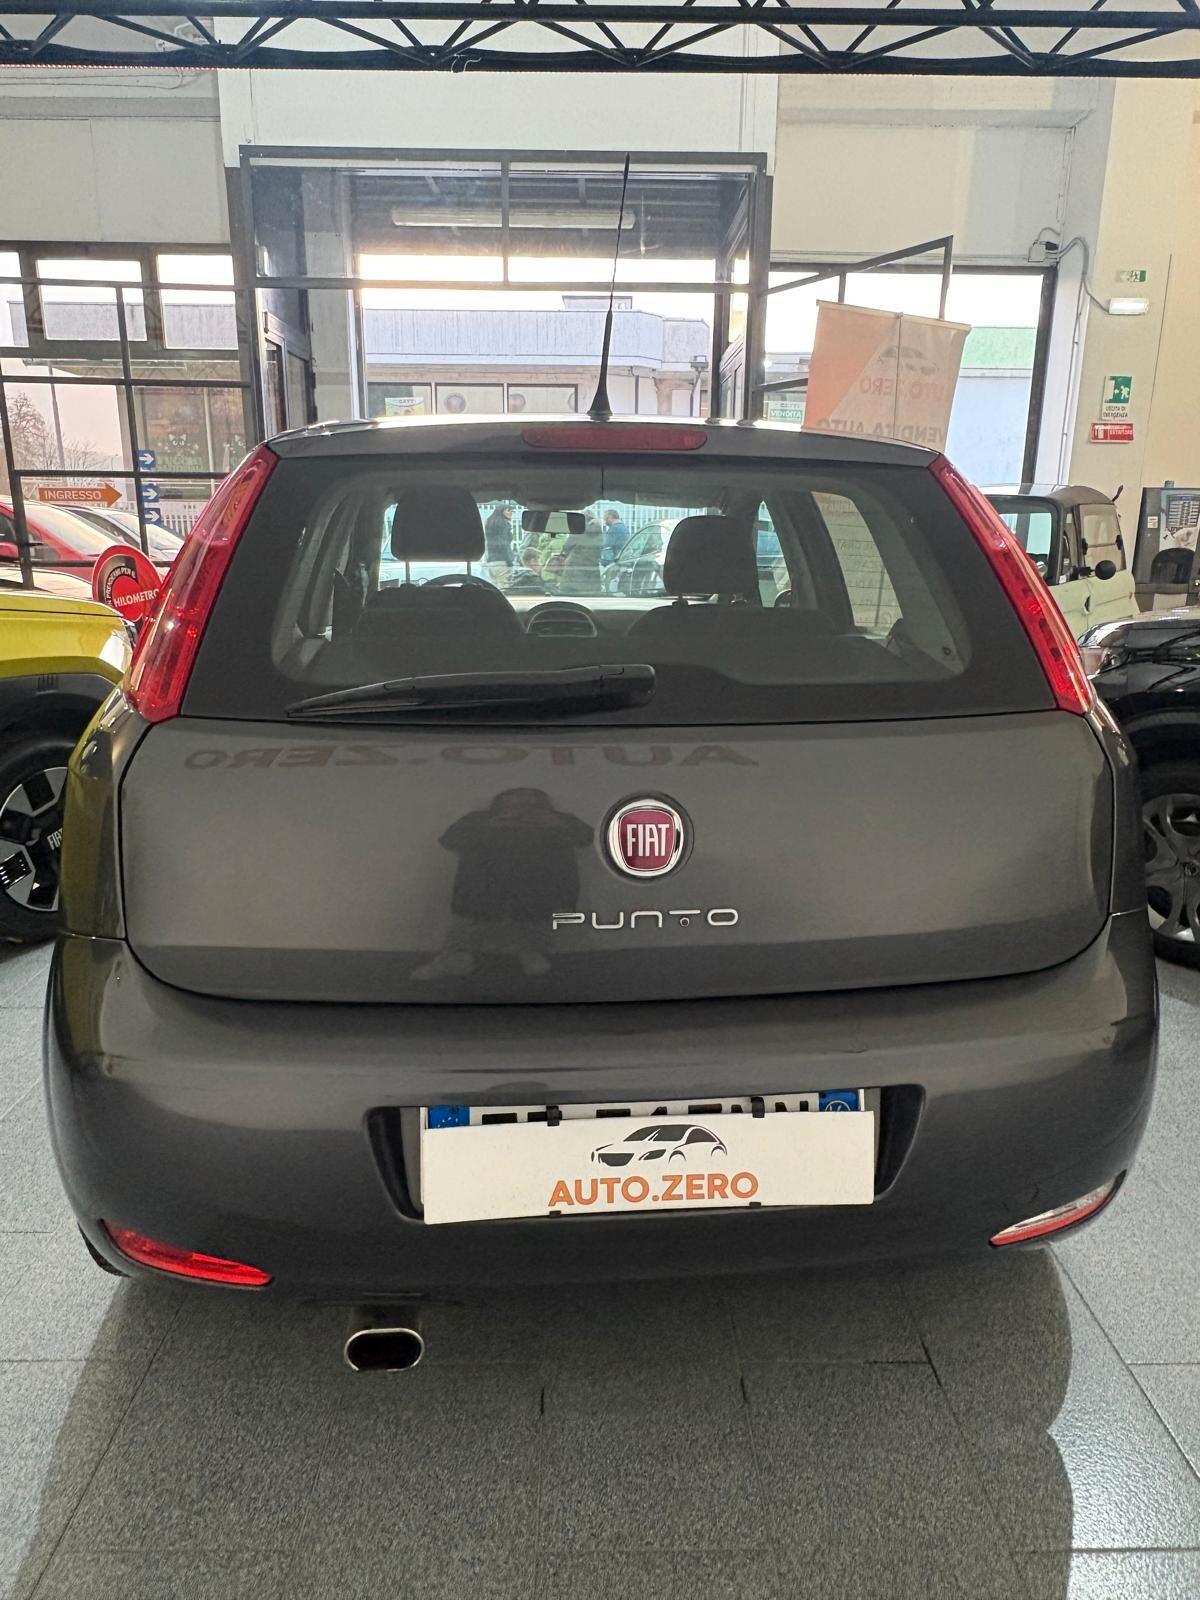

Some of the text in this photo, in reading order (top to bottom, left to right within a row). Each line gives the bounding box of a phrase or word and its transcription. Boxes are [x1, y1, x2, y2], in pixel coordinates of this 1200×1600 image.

[44, 490, 102, 500] INGRESSO
[626, 823, 670, 857] FIAT
[552, 908, 739, 930] PUNTO
[548, 1171, 759, 1207] AUTO.ZERO
